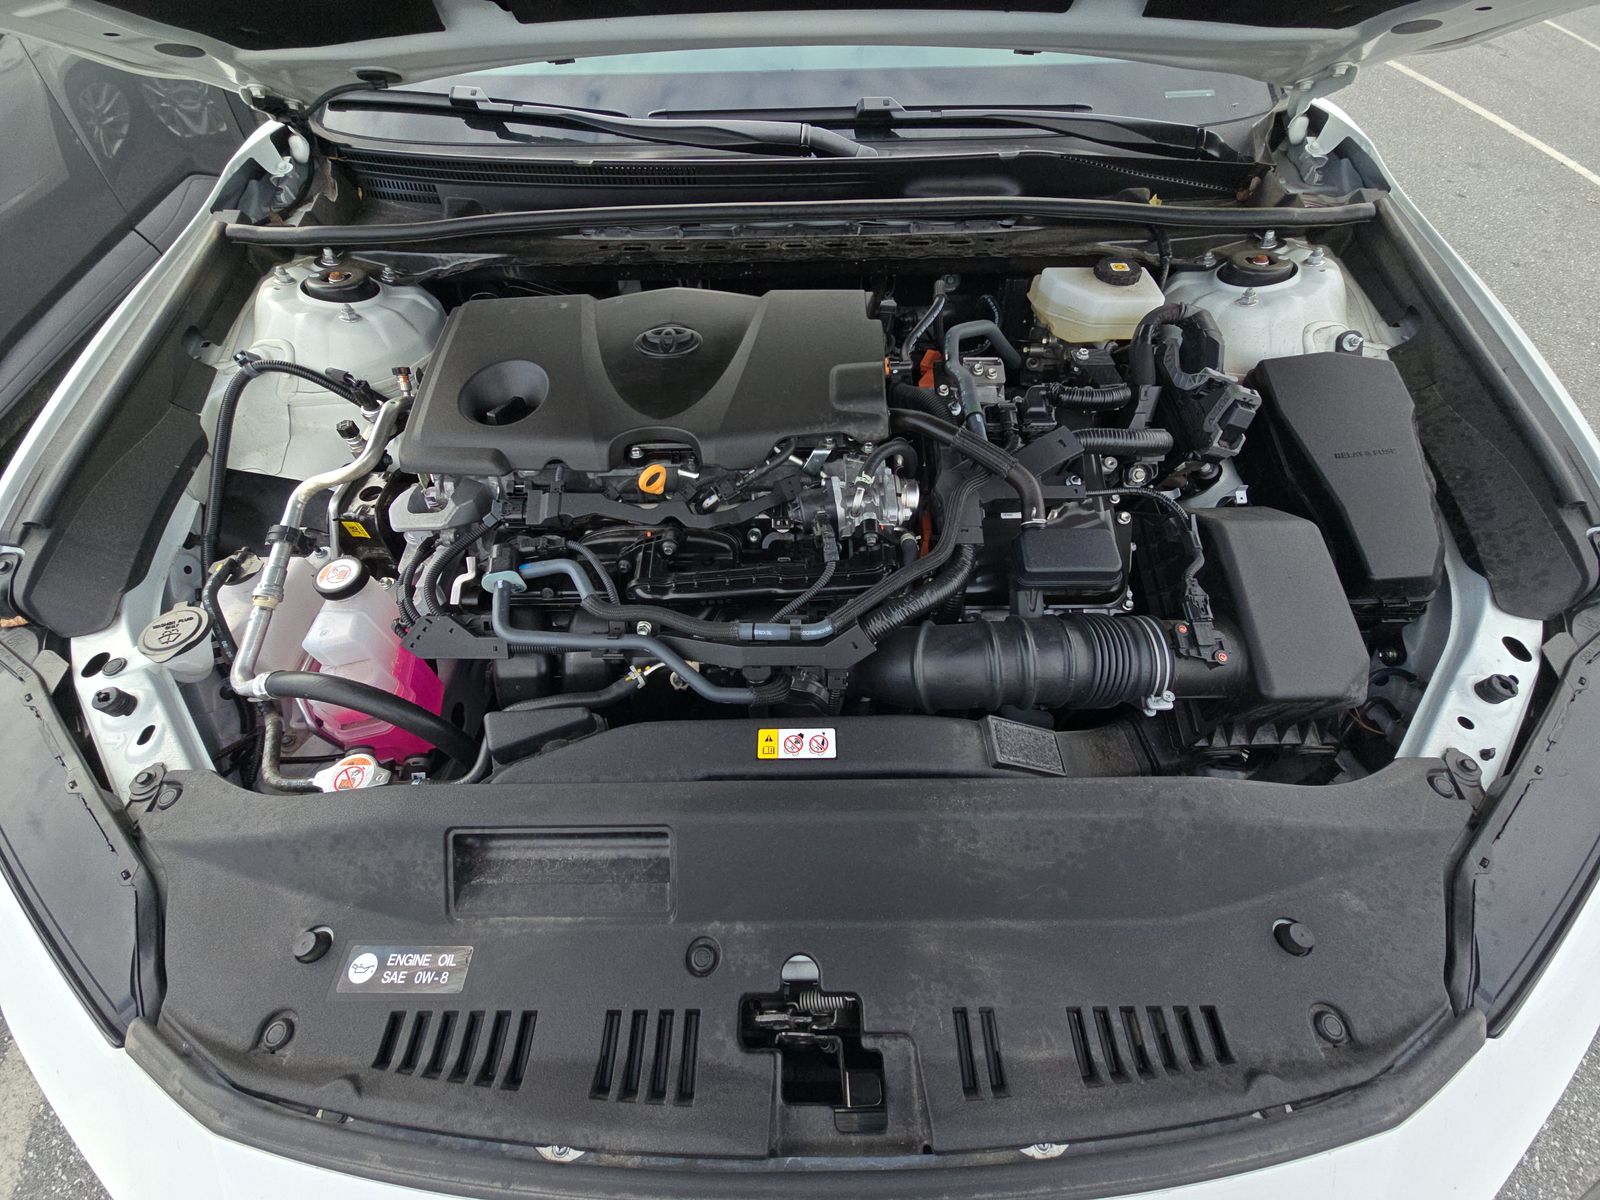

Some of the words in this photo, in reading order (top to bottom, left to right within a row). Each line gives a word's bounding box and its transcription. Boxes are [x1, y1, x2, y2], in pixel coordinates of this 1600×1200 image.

[1334, 451, 1362, 459] RELAY
[387, 954, 432, 966] ENGINE
[438, 954, 456, 966] OIL
[381, 971, 407, 984] SAE
[414, 971, 449, 984] 0W-8
